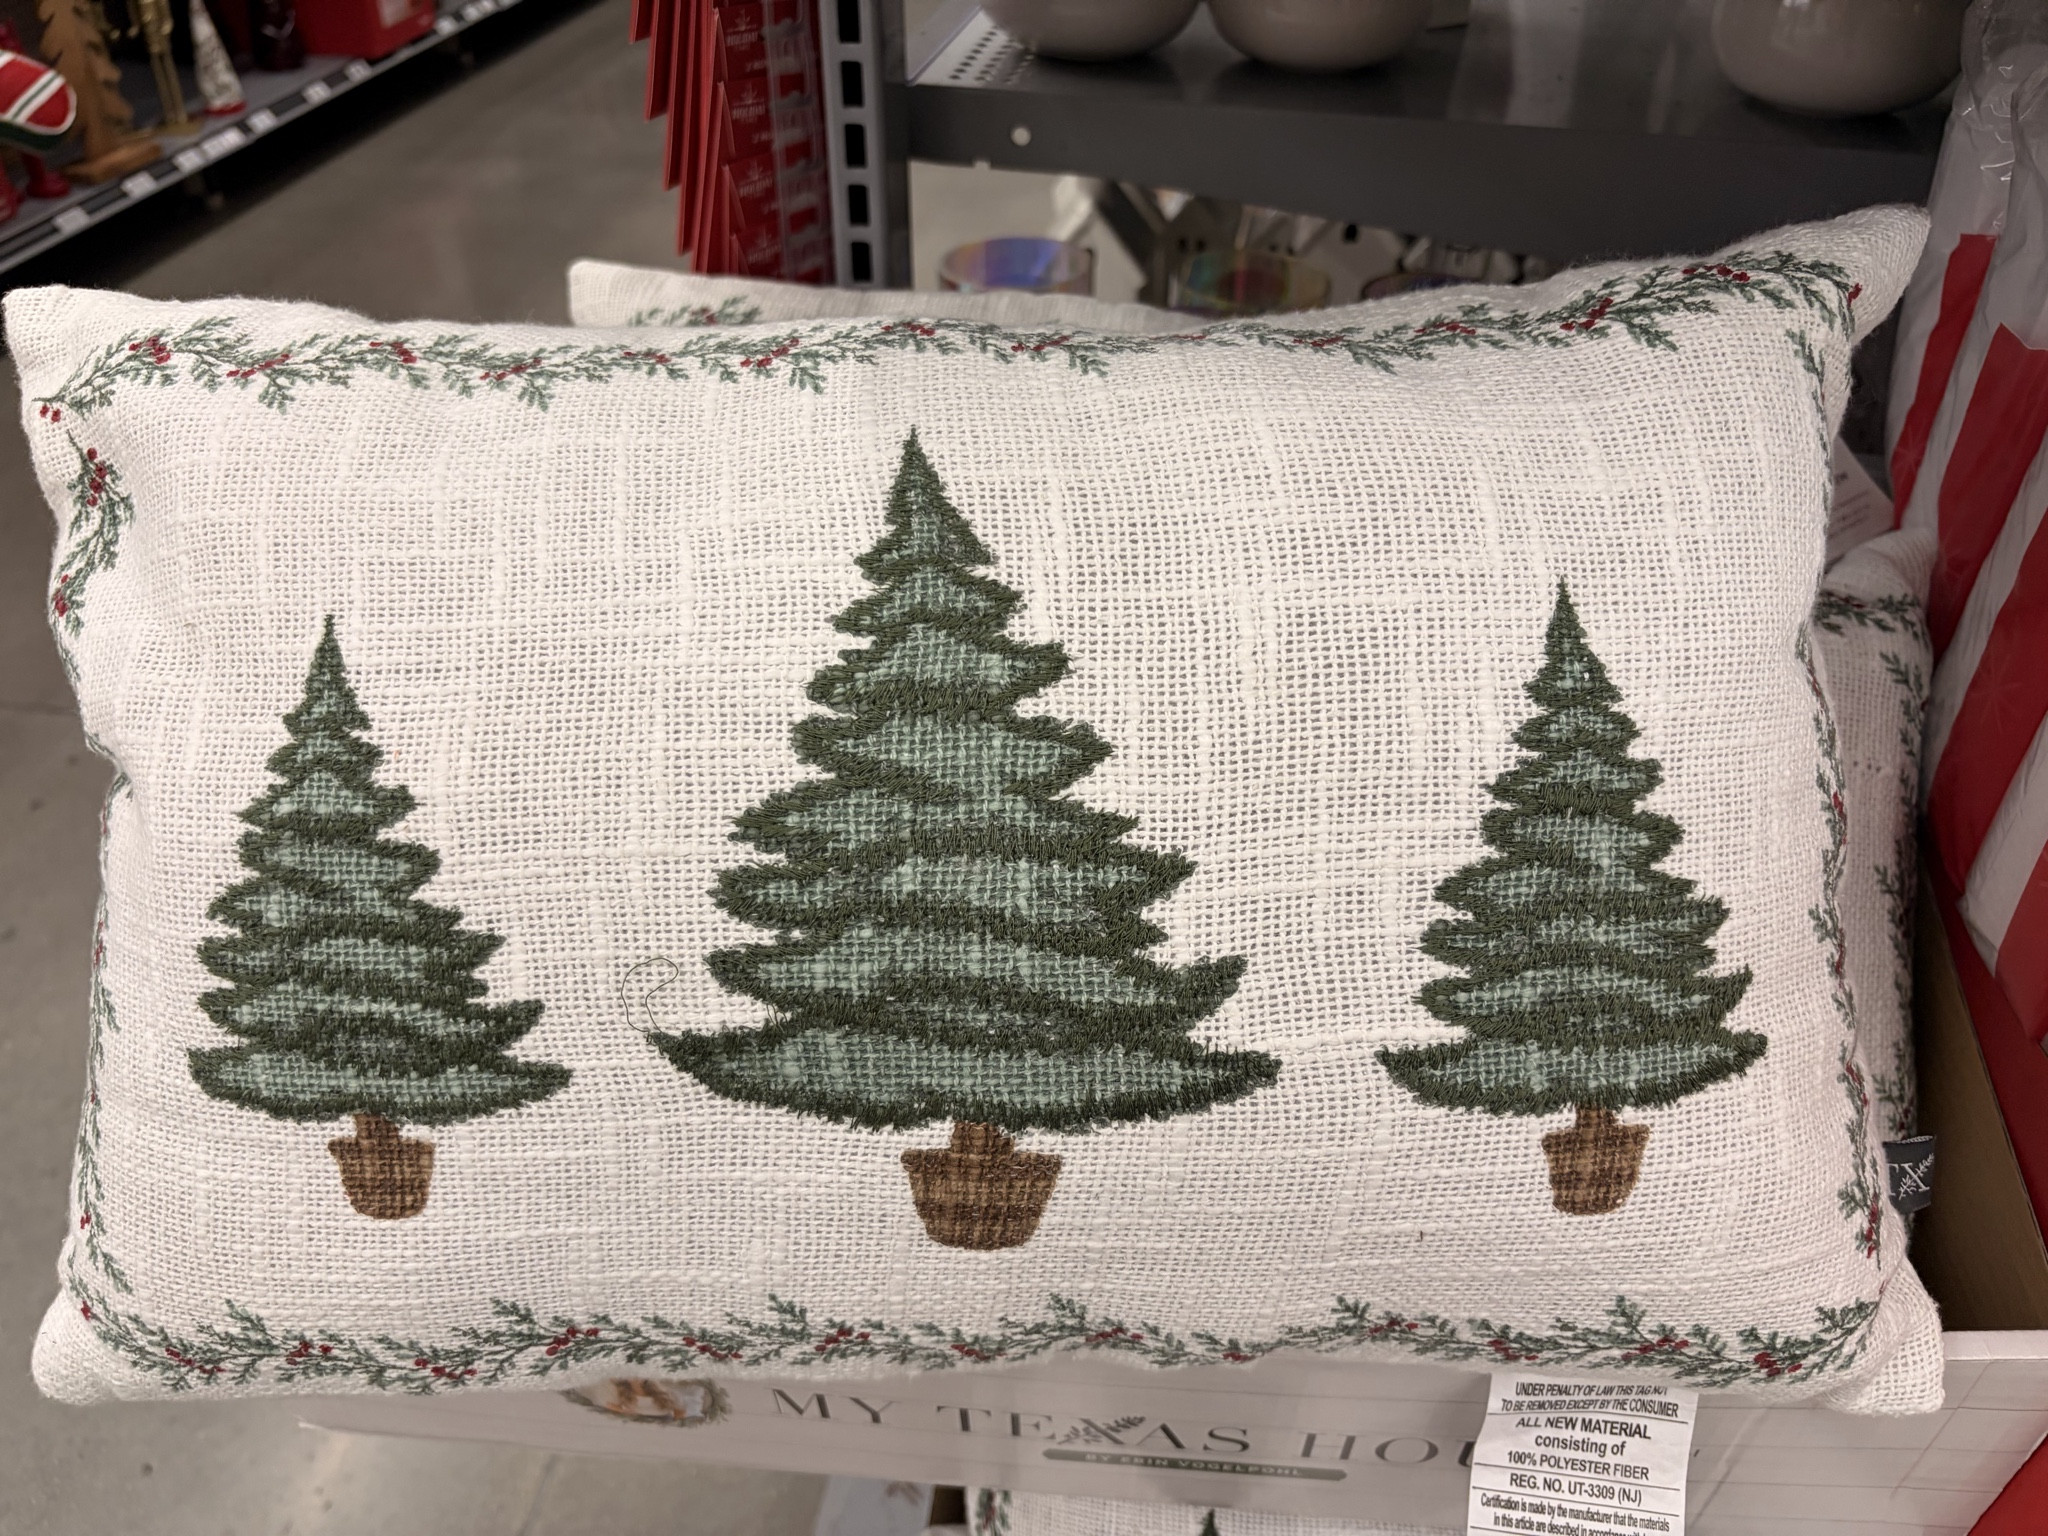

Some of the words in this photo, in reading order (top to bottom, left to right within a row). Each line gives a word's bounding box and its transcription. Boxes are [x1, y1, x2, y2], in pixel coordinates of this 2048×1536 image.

[1515, 1381, 1545, 1397] UNDER
[1545, 1383, 1584, 1397] PENALTY
[1583, 1385, 1597, 1396] OF
[1595, 1385, 1615, 1396] LAW
[1615, 1385, 1635, 1396] THIS
[1635, 1385, 1652, 1395] TAG
[770, 1388, 896, 1424] MY
[1501, 1398, 1513, 1412] TO
[1513, 1400, 1527, 1411] BE
[1526, 1400, 1566, 1411] REMOVED
[1566, 1399, 1600, 1410] EXCEPT
[1599, 1399, 1612, 1410] BY
[1611, 1399, 1629, 1412] THE
[1629, 1399, 1679, 1418] CONSUMER
[1515, 1416, 1542, 1428] ALL
[1544, 1416, 1579, 1431] NEW
[1580, 1417, 1652, 1440] MATERIAL
[1534, 1434, 1608, 1458] consisting
[1610, 1440, 1627, 1456] of
[1507, 1450, 1538, 1467] 100%
[1539, 1454, 1611, 1476] POLYESTER
[1613, 1463, 1650, 1481] FIBER
[1509, 1472, 1541, 1490] REG.
[1542, 1476, 1566, 1493] NO.
[1568, 1480, 1615, 1500] UT-3309
[1617, 1487, 1642, 1507] (NJ)
[1480, 1492, 1520, 1512] Certification
[1520, 1497, 1527, 1512] is
[1527, 1500, 1546, 1515] made
[1547, 1501, 1556, 1520] by
[1556, 1503, 1568, 1518] the
[1568, 1506, 1613, 1524] manufacturer
[1613, 1511, 1626, 1526] that
[1627, 1513, 1638, 1528] the
[1638, 1516, 1670, 1532] materials
[1493, 1511, 1500, 1526] in
[1501, 1513, 1514, 1528] this
[1514, 1515, 1535, 1531] article
[1535, 1521, 1547, 1533] are
[1547, 1520, 1580, 1536] described
